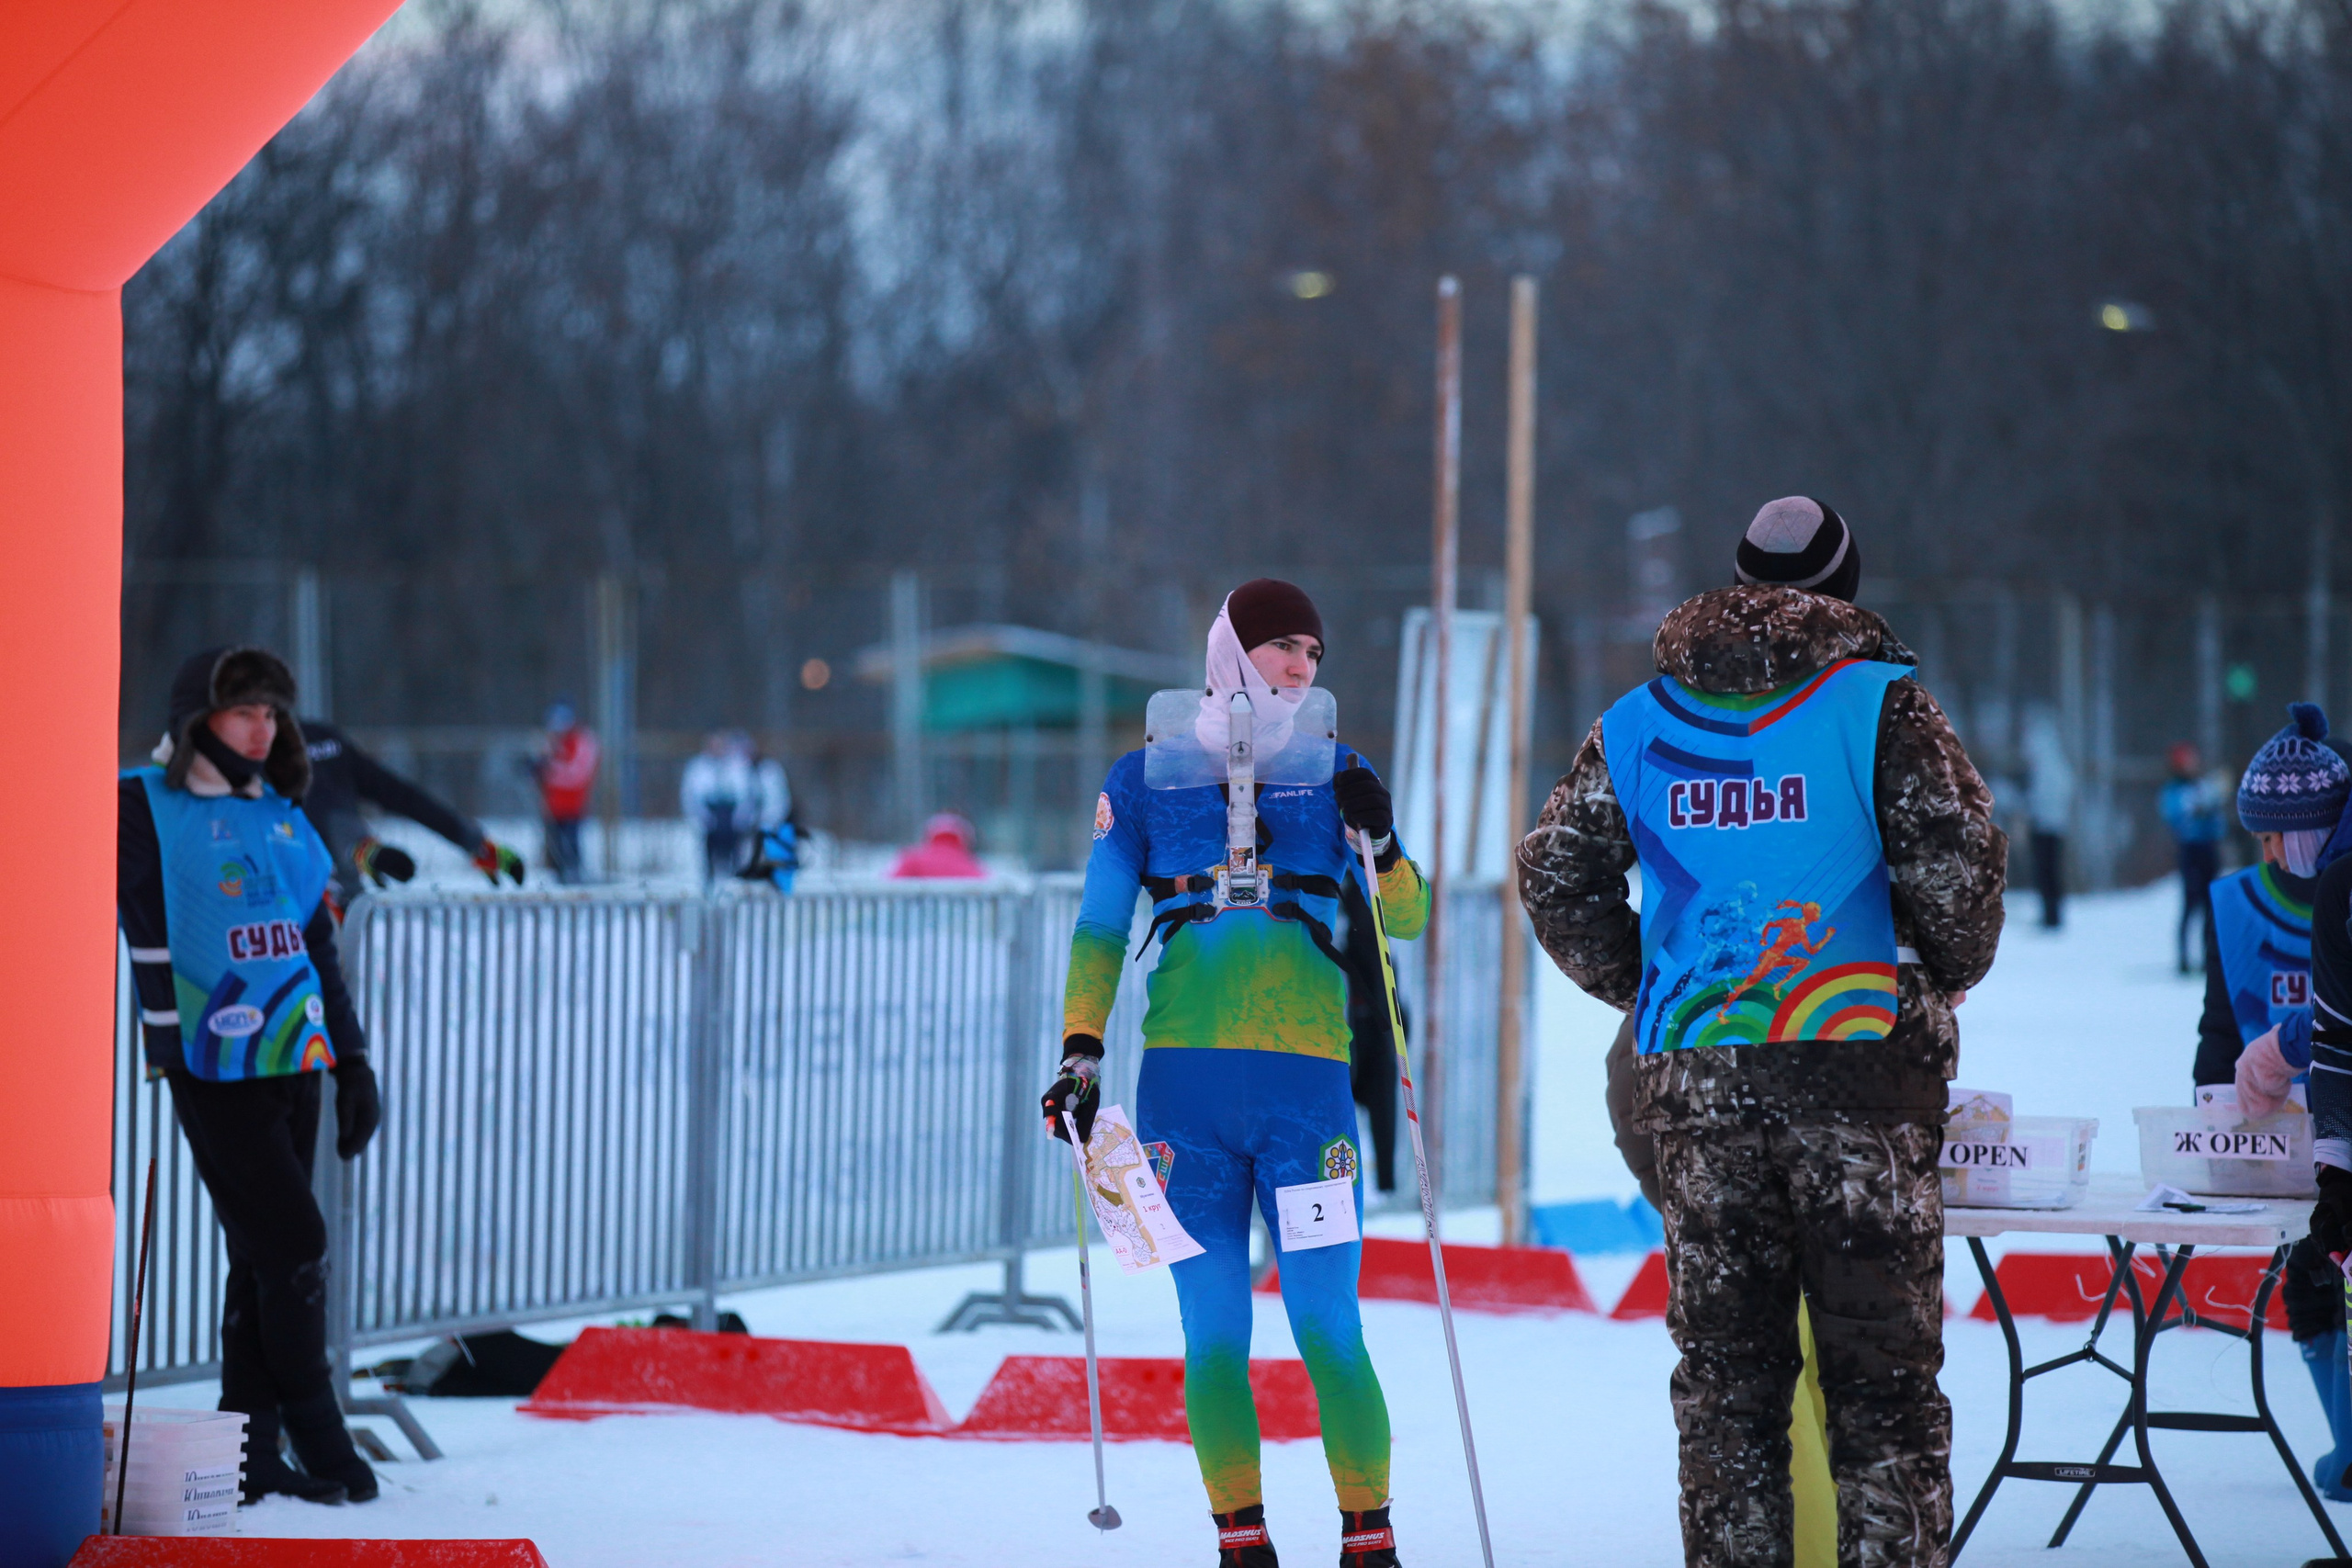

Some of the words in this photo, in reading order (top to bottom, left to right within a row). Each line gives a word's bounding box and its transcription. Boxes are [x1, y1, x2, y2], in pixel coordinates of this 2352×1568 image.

[1273, 789, 1314, 798] FANLIFE
[1668, 774, 1807, 829] СУДЬЯ
[228, 921, 303, 961] СУДЬ
[2175, 1132, 2202, 1153] Ж
[2210, 1133, 2287, 1156] OPEN
[1949, 1143, 2029, 1168] OPEN
[1311, 1202, 1325, 1223] 2
[1220, 1529, 1261, 1540] MADSHUS
[1342, 1532, 1385, 1544] MADSHUS
